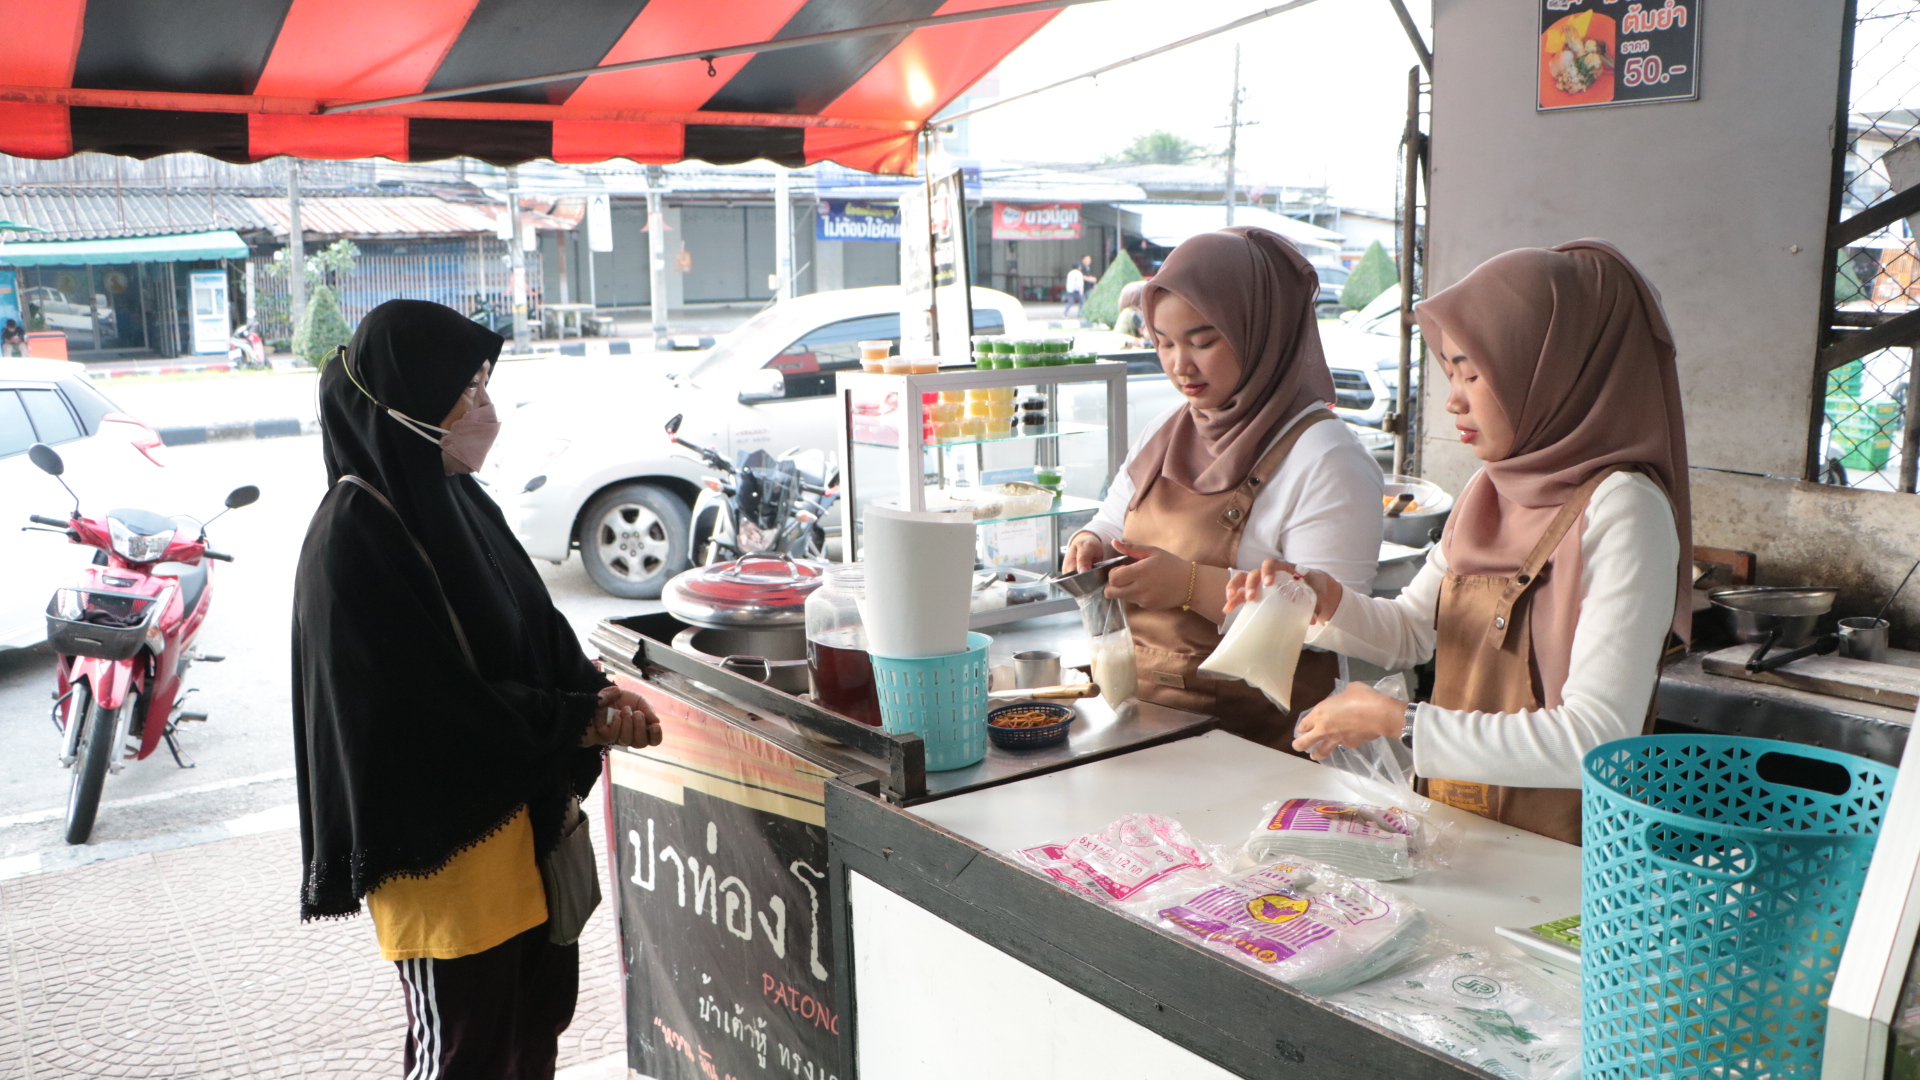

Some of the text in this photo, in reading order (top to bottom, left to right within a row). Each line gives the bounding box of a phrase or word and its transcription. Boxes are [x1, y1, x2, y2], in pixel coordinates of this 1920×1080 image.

[1622, 0, 1688, 34] ต้มยำ
[1620, 39, 1649, 54] ราคา
[1623, 55, 1687, 87] 50.-
